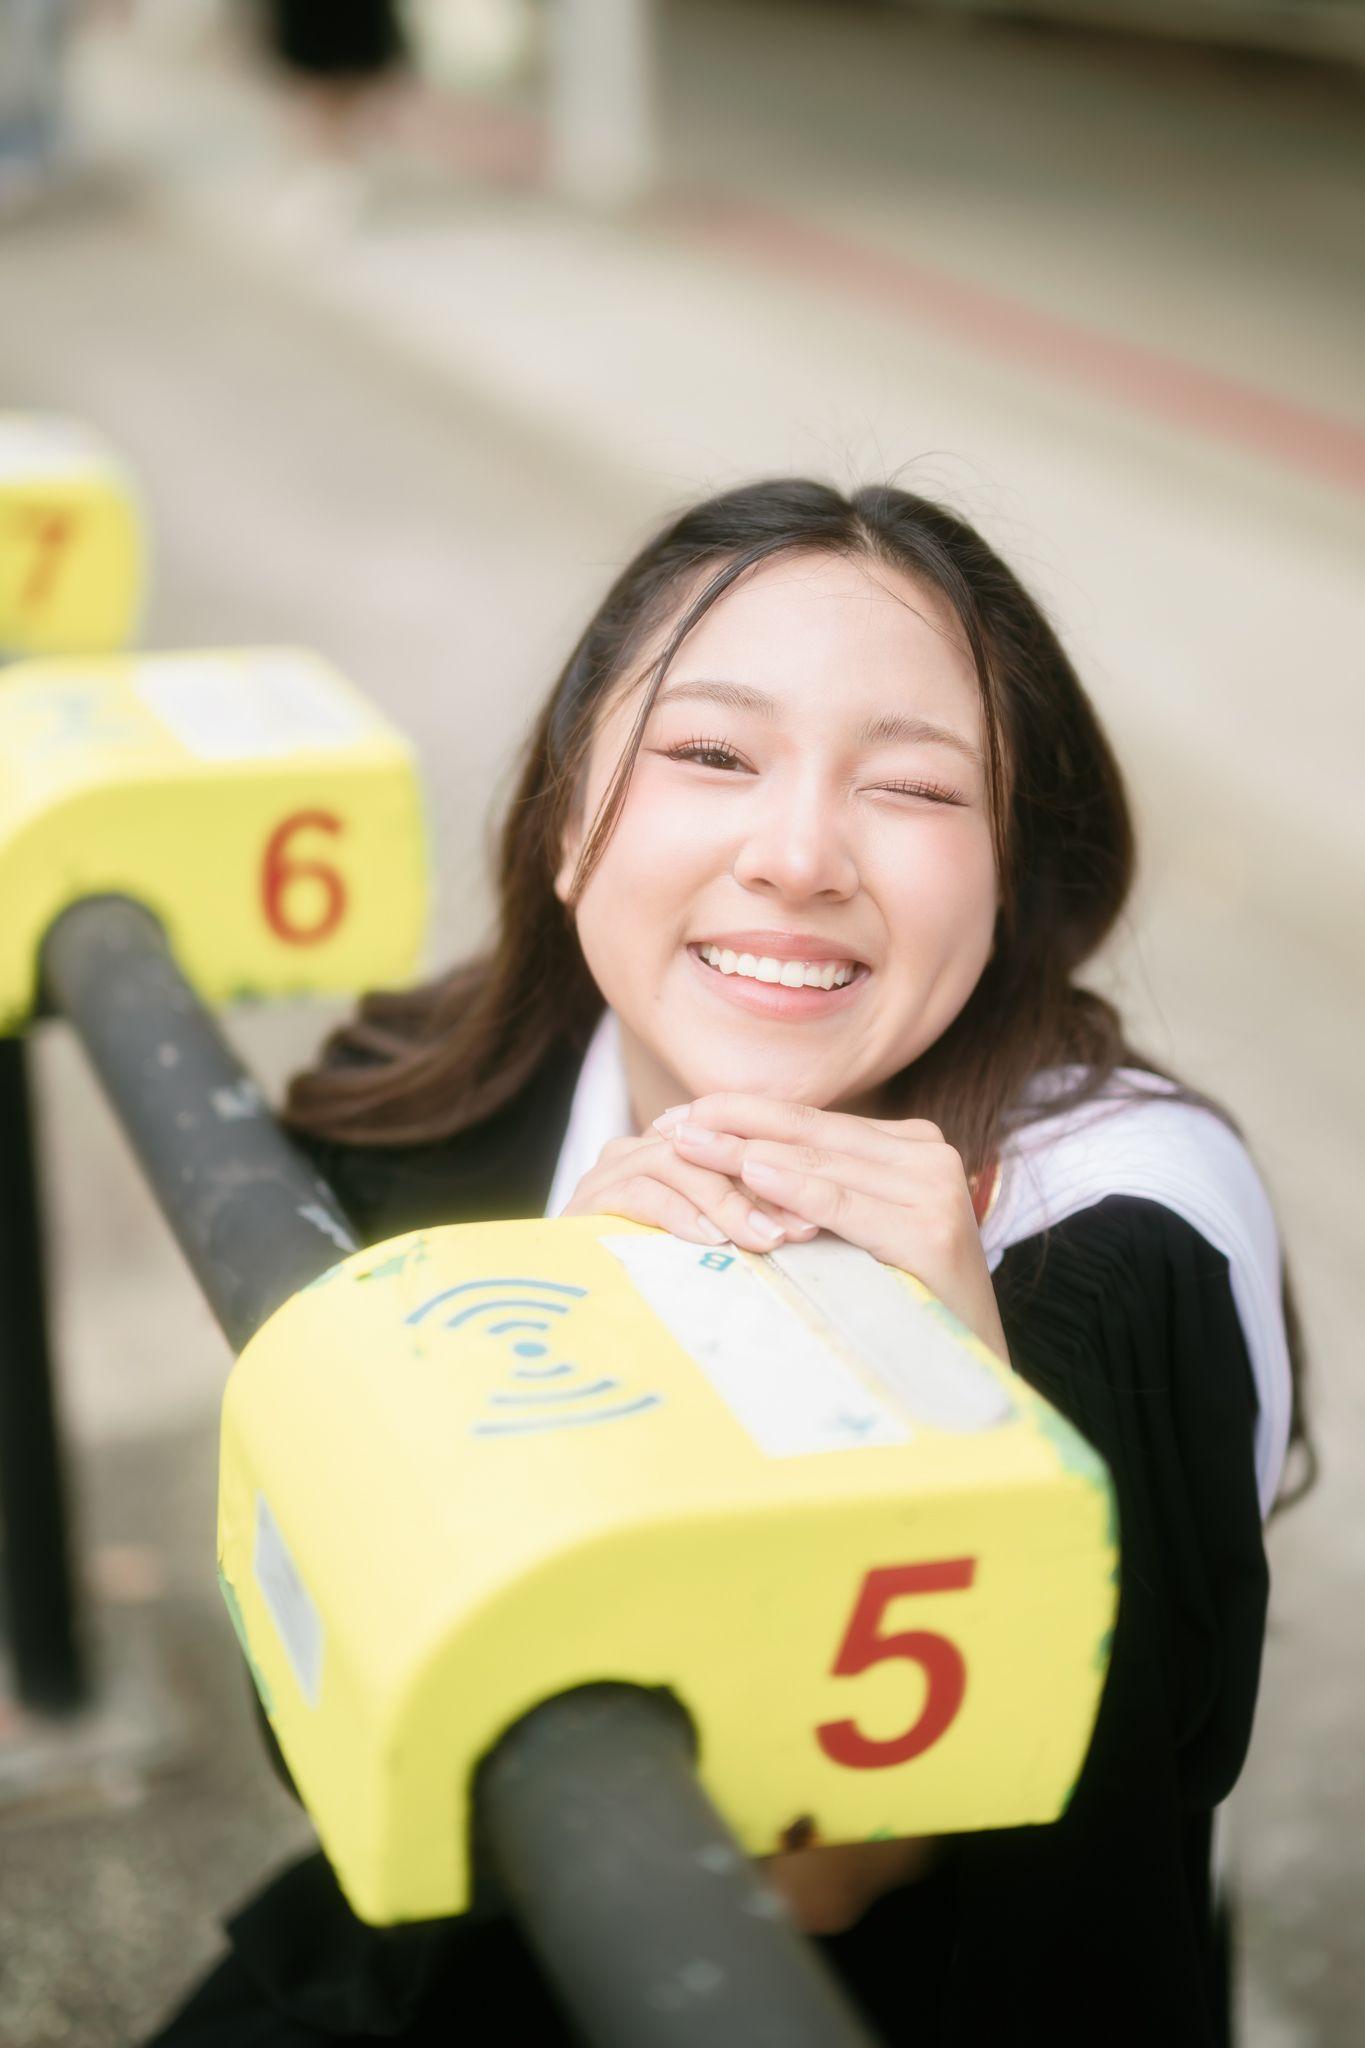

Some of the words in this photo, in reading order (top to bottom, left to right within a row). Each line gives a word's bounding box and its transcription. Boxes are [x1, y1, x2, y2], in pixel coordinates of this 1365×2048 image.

[6, 504, 78, 613] 7
[258, 808, 350, 948] 6
[814, 1556, 977, 1771] 5
